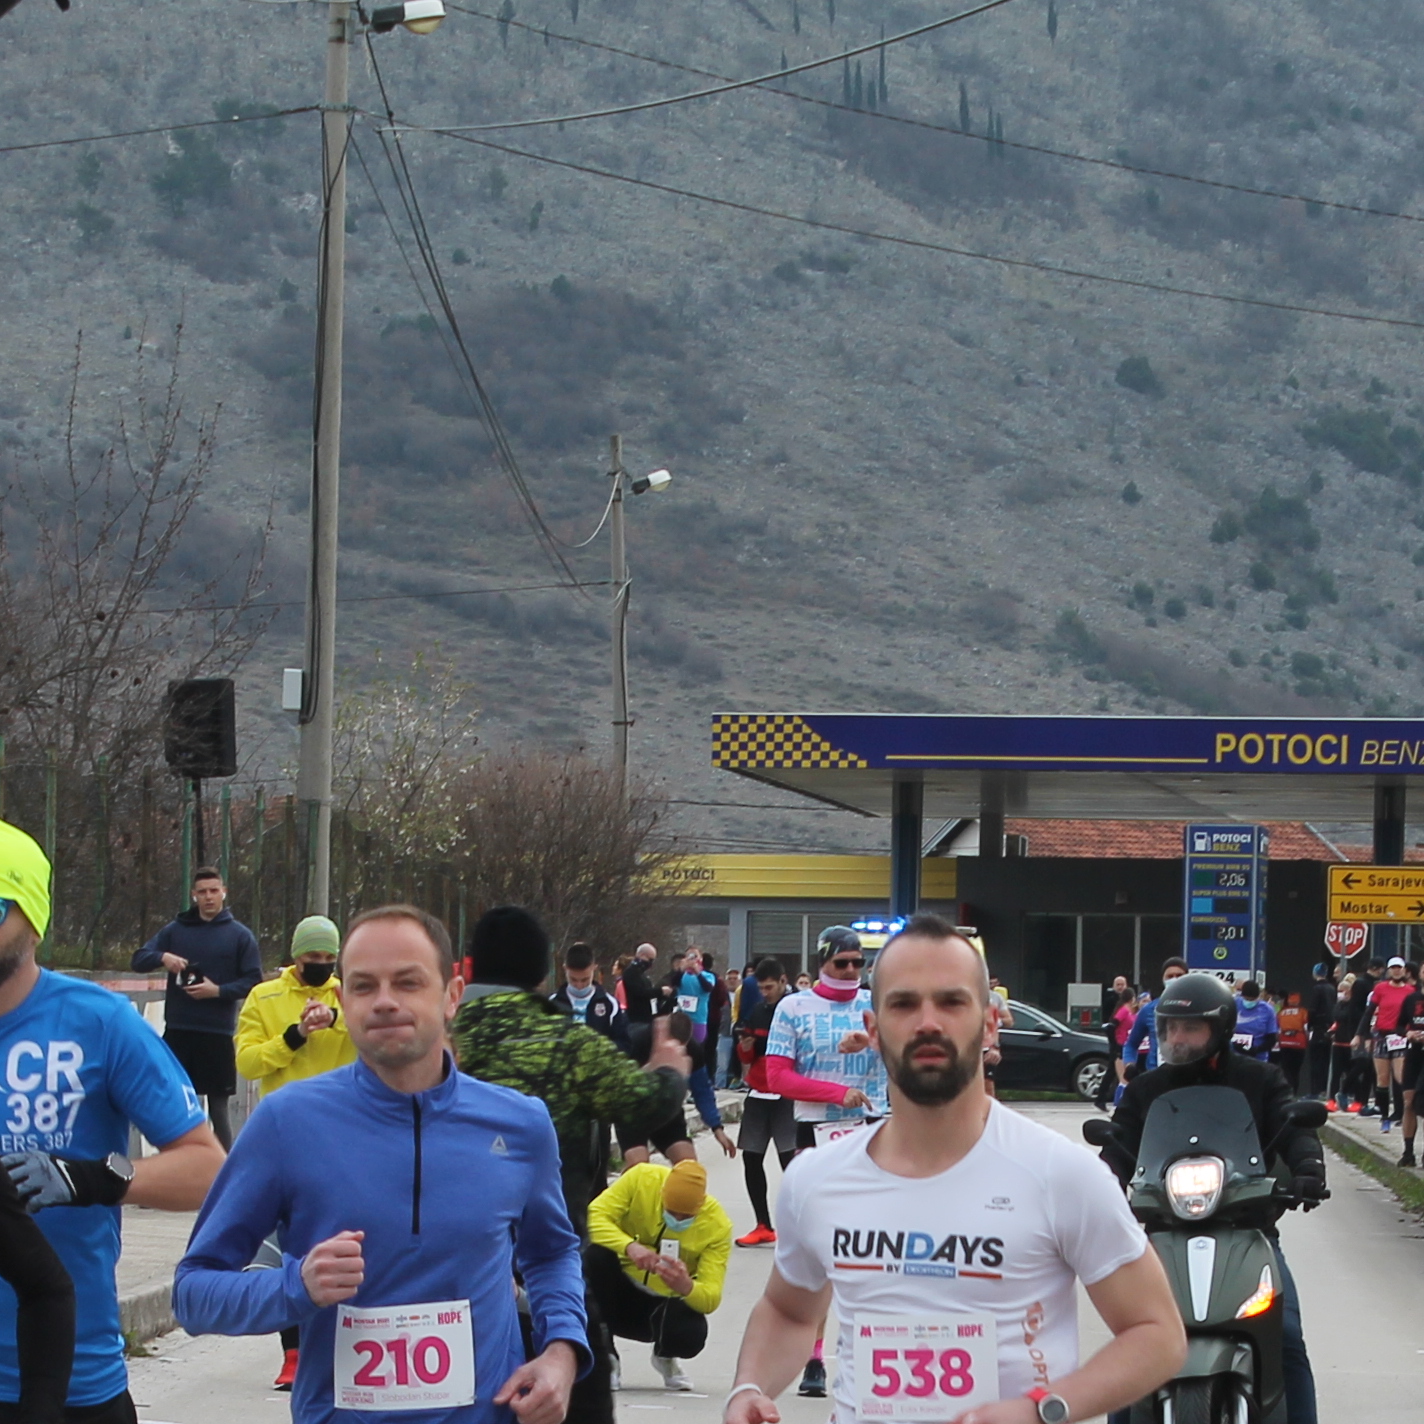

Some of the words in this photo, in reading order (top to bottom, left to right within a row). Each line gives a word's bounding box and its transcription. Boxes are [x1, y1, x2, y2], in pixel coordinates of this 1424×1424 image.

[1215, 733, 1348, 765] POTOCI
[1212, 833, 1251, 843] POTOCI
[1213, 843, 1241, 852] BENZ
[1340, 901, 1388, 914] Mostar
[1328, 925, 1363, 946] STOP
[6, 1041, 84, 1093] CR
[6, 1092, 85, 1134] 387
[44, 1131, 74, 1151] 387
[833, 1228, 1004, 1267] RUNDAYS
[886, 1264, 901, 1274] BY
[437, 1311, 462, 1325] HOPE
[957, 1324, 983, 1337] HOPE
[353, 1336, 450, 1386] 210
[872, 1348, 974, 1398] 538
